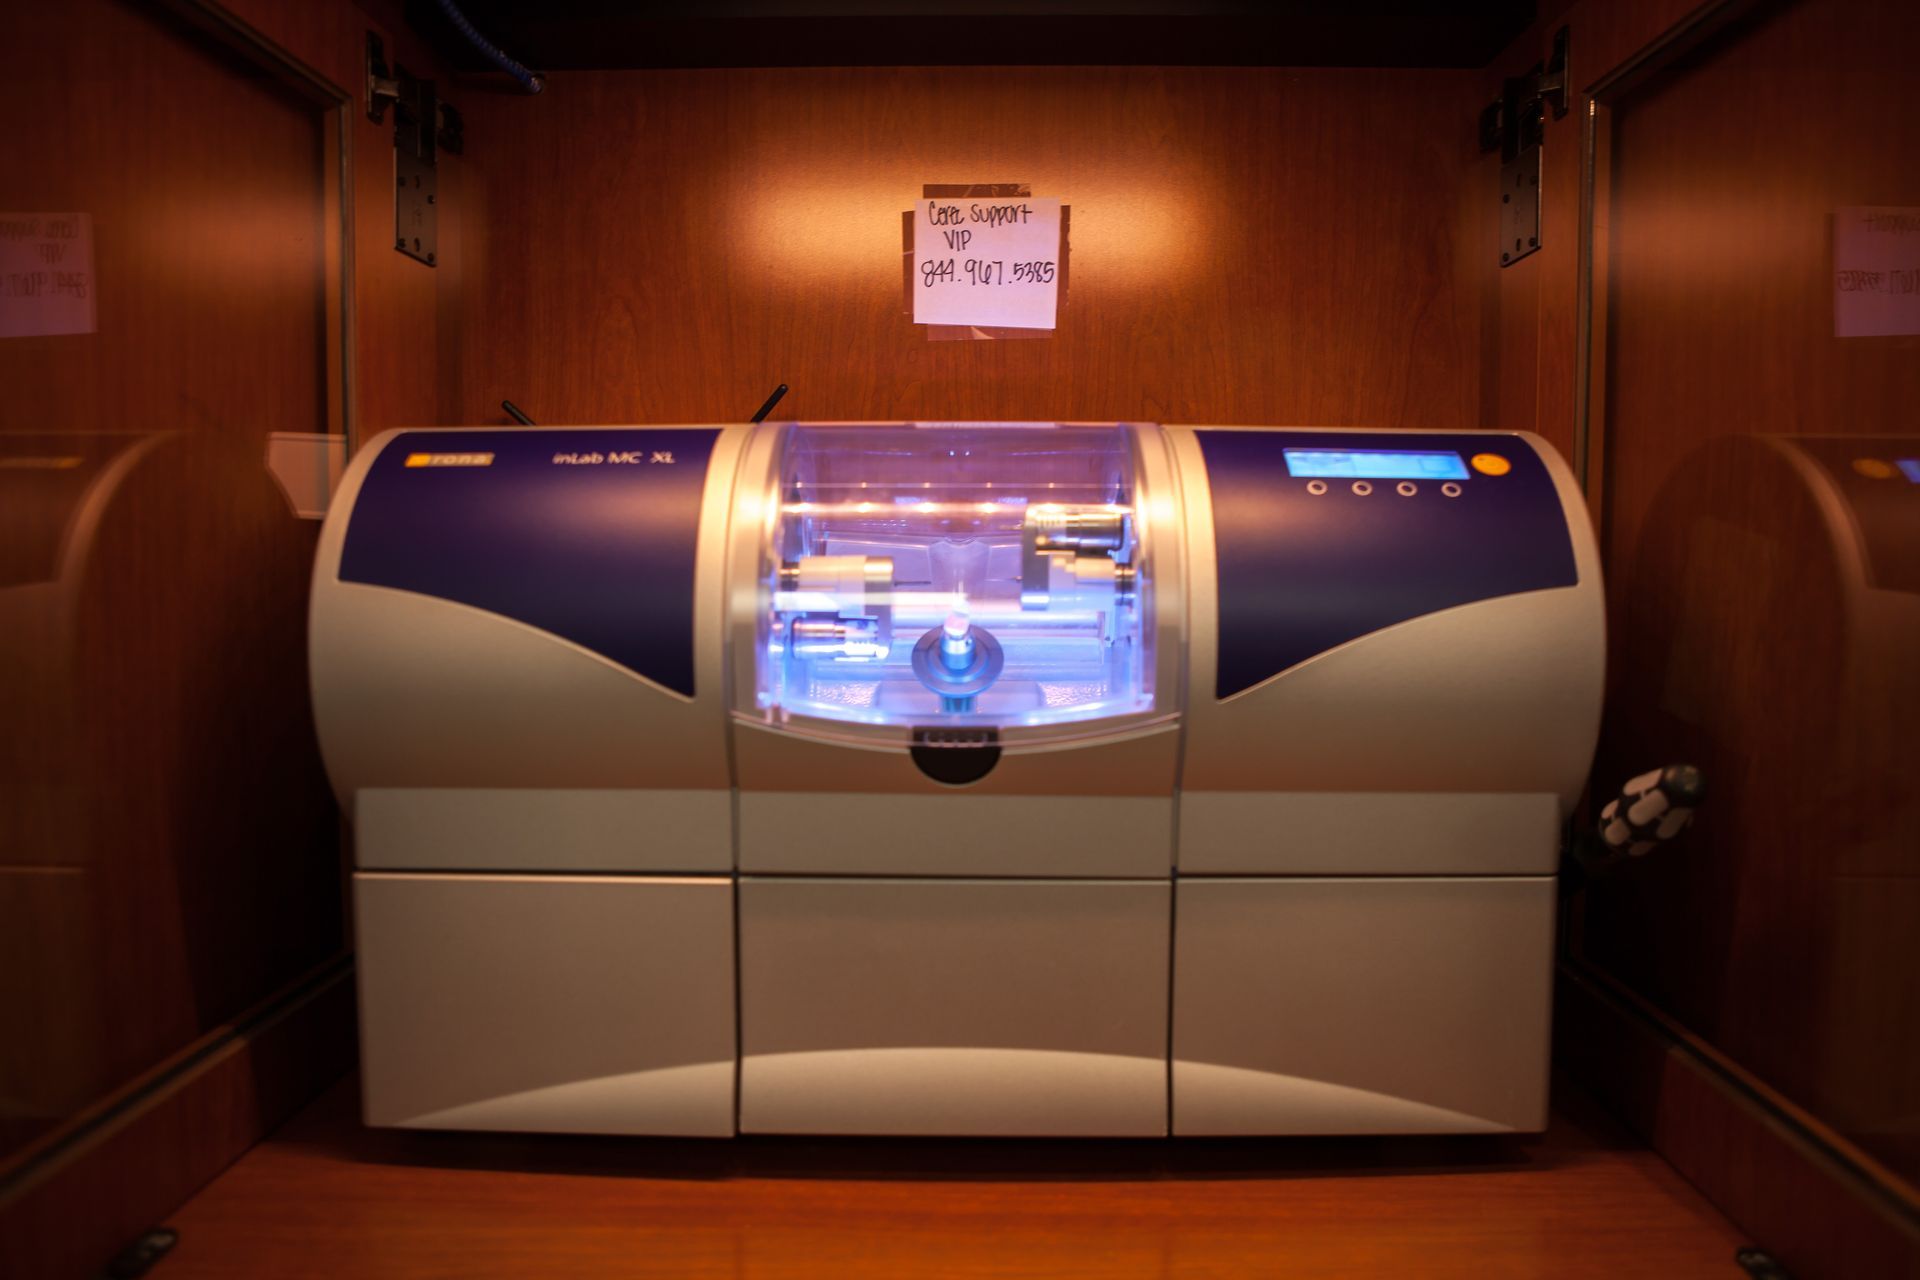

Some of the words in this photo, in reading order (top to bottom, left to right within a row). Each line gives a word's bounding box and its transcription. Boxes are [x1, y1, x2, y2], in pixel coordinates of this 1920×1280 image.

[928, 200, 965, 226] Cerec
[970, 203, 1033, 228] Support
[943, 229, 972, 251] VIP
[920, 258, 1055, 288] 844.967.5385
[552, 452, 604, 464] inLab
[607, 451, 643, 464] MC
[649, 451, 675, 464] XL
